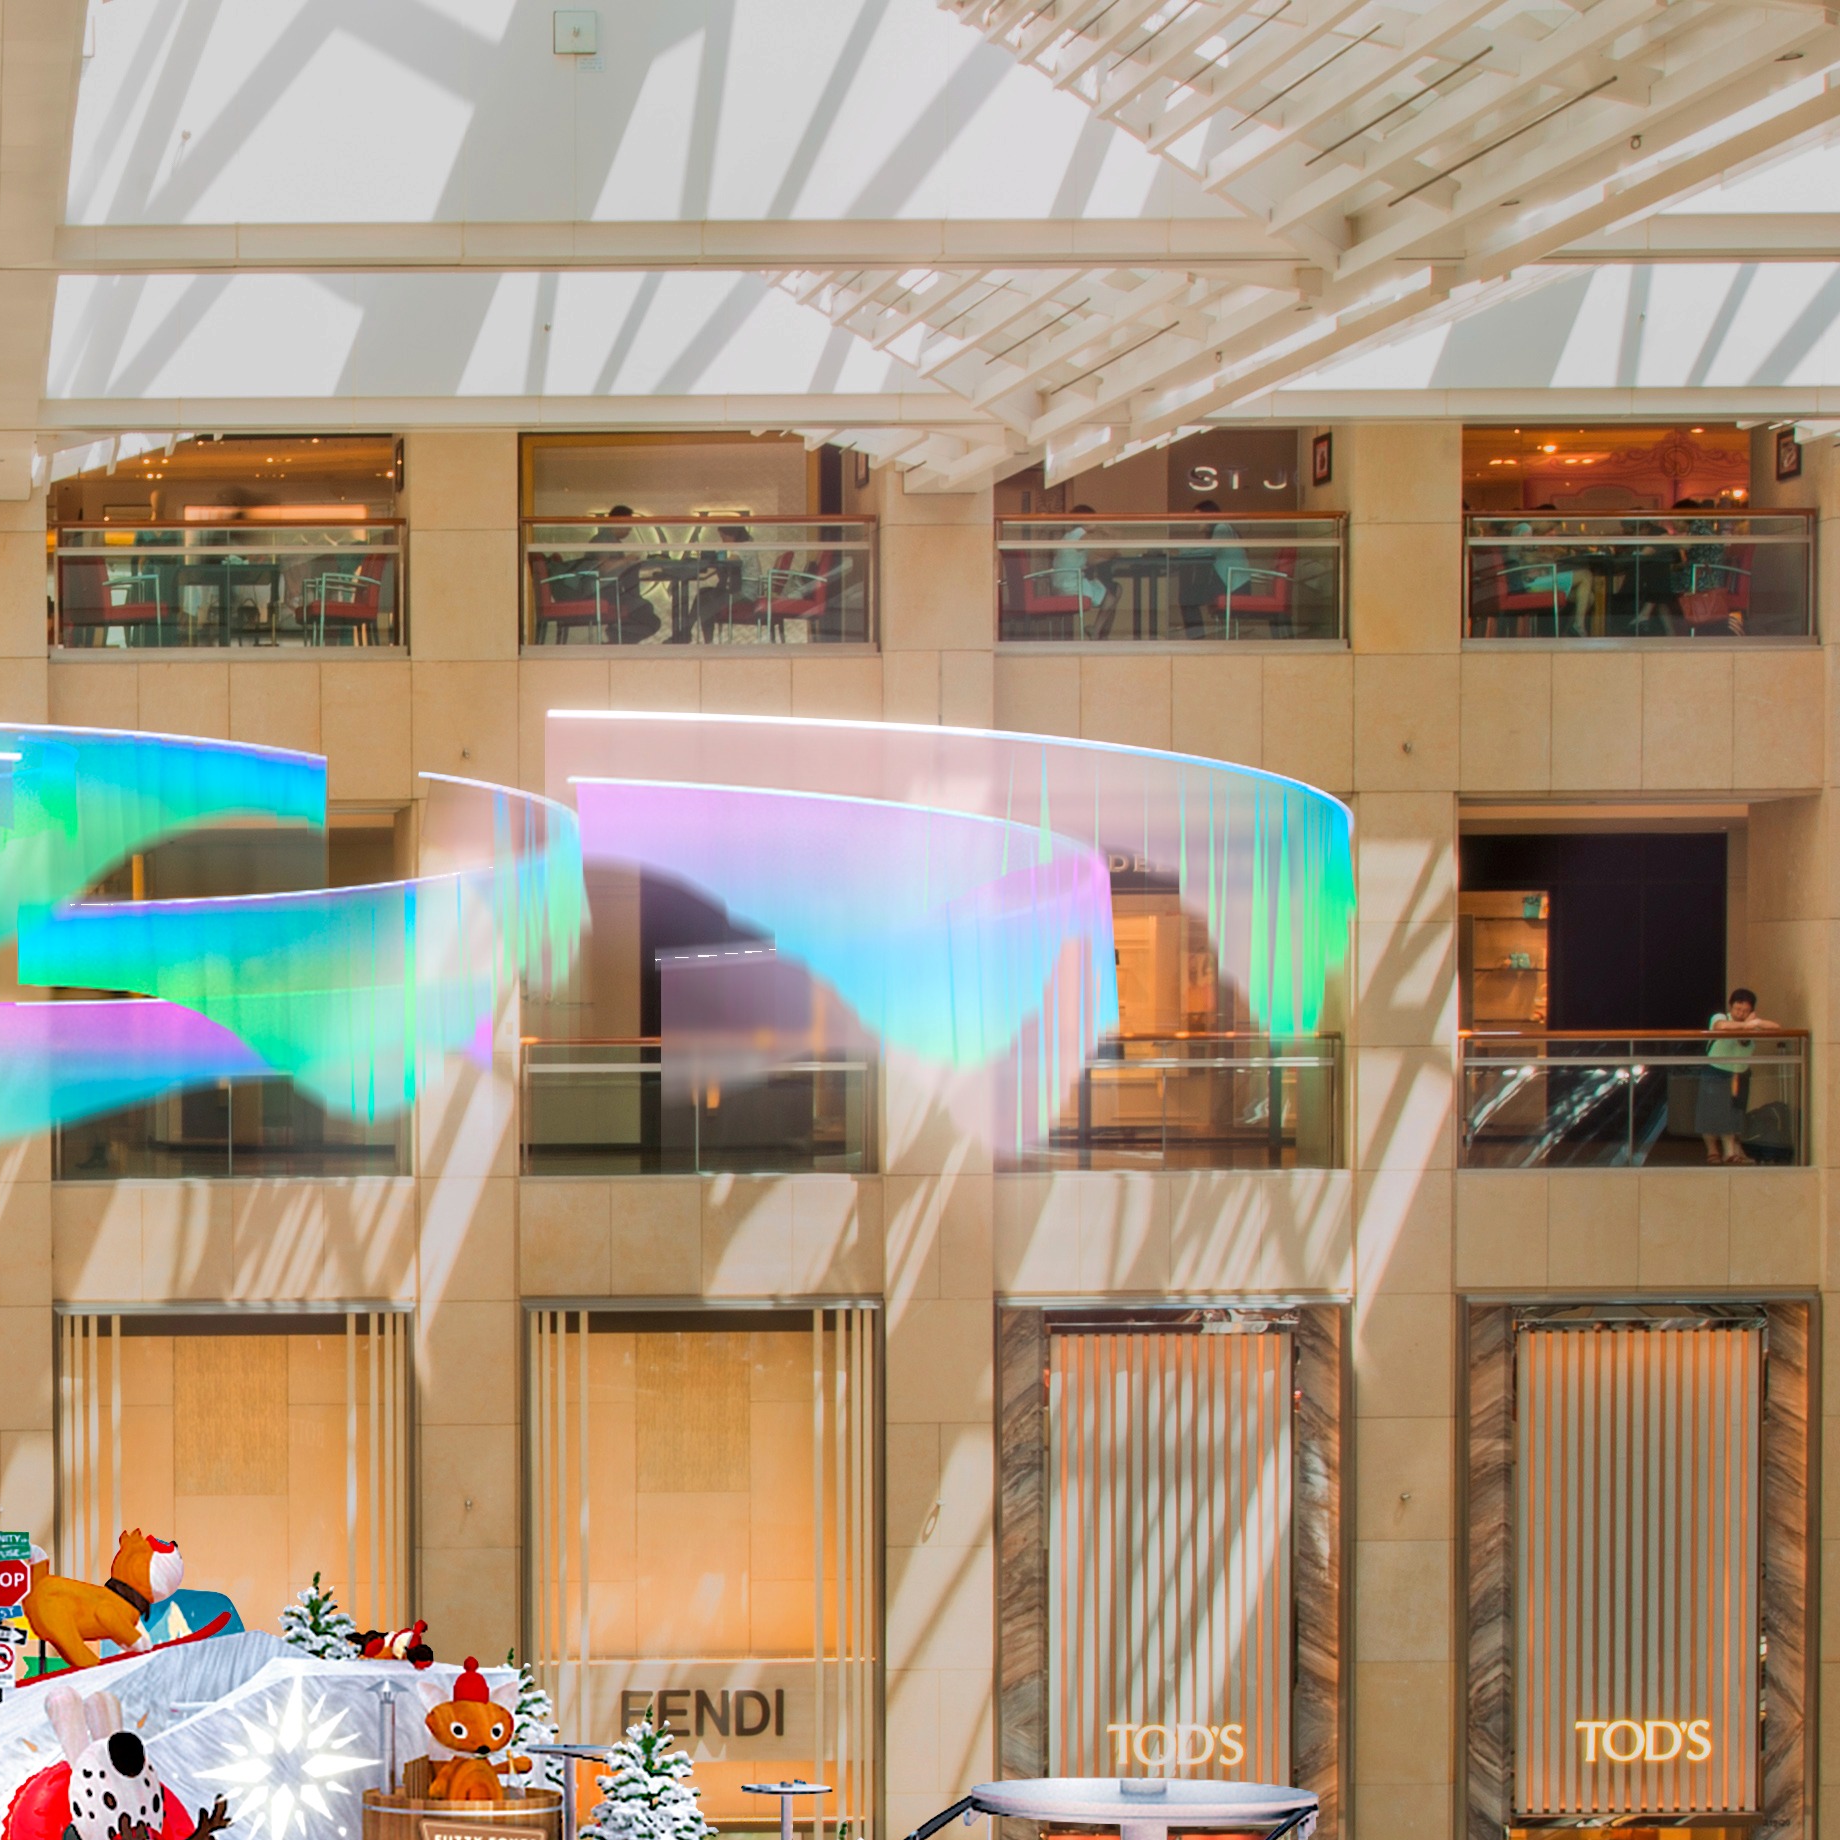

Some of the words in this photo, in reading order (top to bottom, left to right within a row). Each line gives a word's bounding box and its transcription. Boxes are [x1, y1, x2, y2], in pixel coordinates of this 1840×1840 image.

[621, 1689, 784, 1737] FENDI
[1107, 1724, 1243, 1766] TOD'S
[1575, 1720, 1711, 1762] TOD'S
